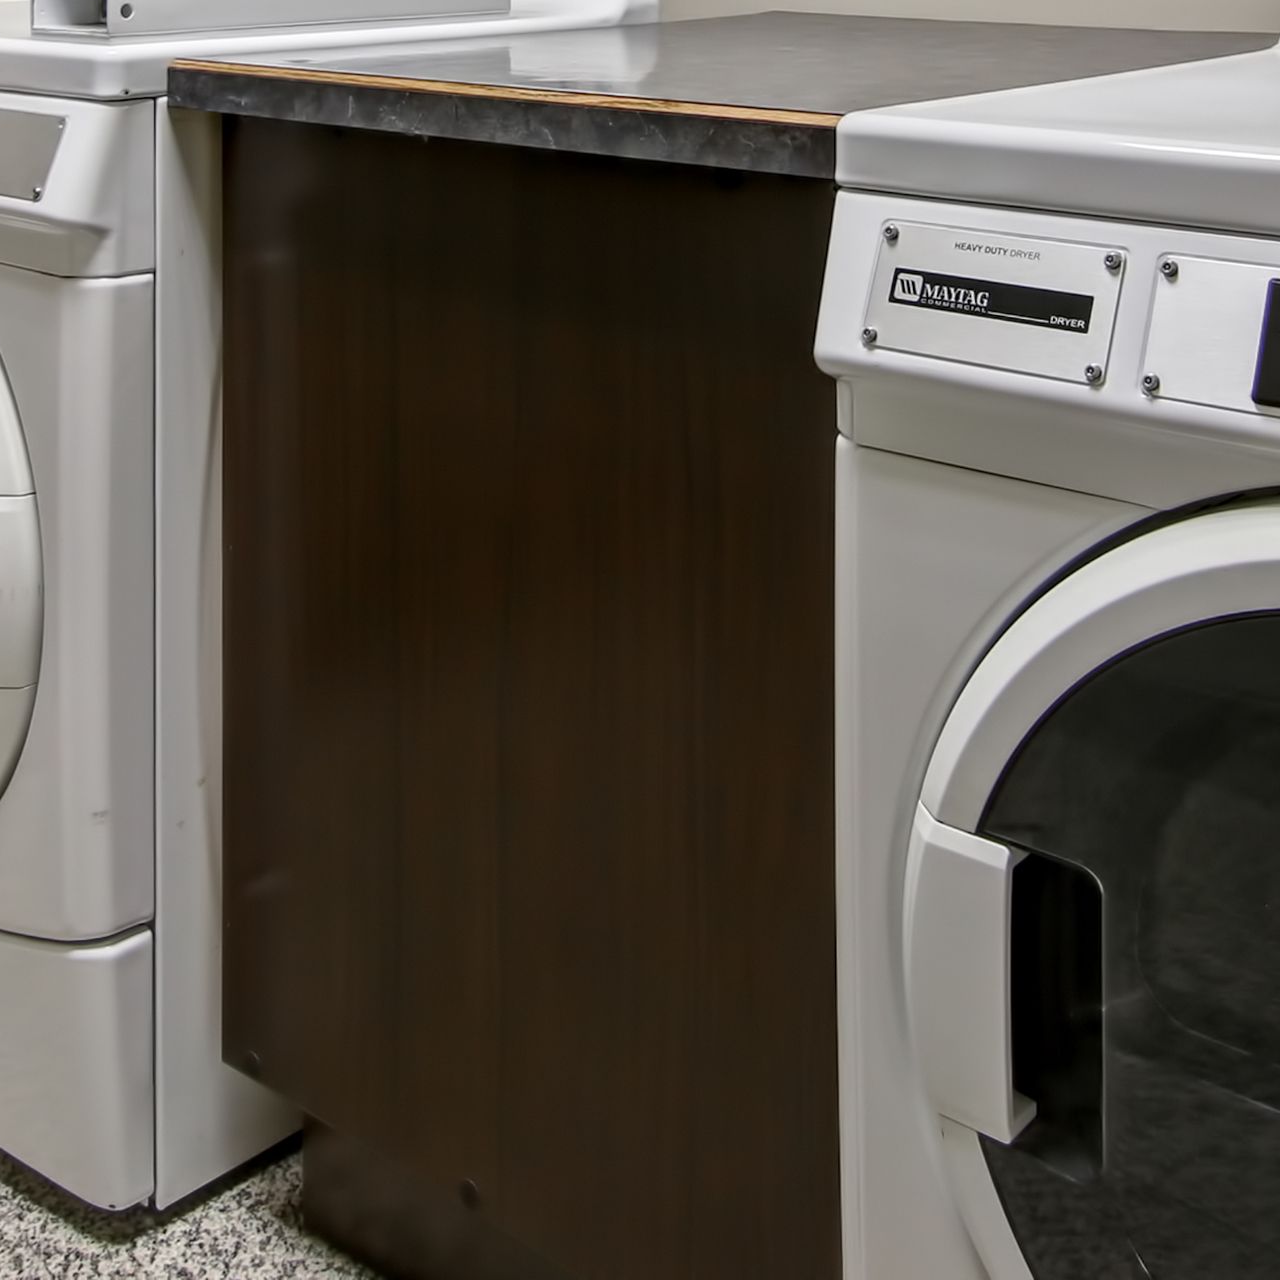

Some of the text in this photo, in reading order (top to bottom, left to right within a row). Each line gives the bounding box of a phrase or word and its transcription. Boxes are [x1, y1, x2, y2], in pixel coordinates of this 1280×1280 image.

[954, 242, 1041, 261] HEAVY DUTY DRYER
[921, 283, 990, 307] MAYTAG
[920, 298, 1086, 329] COMMERCIAL DRYER
